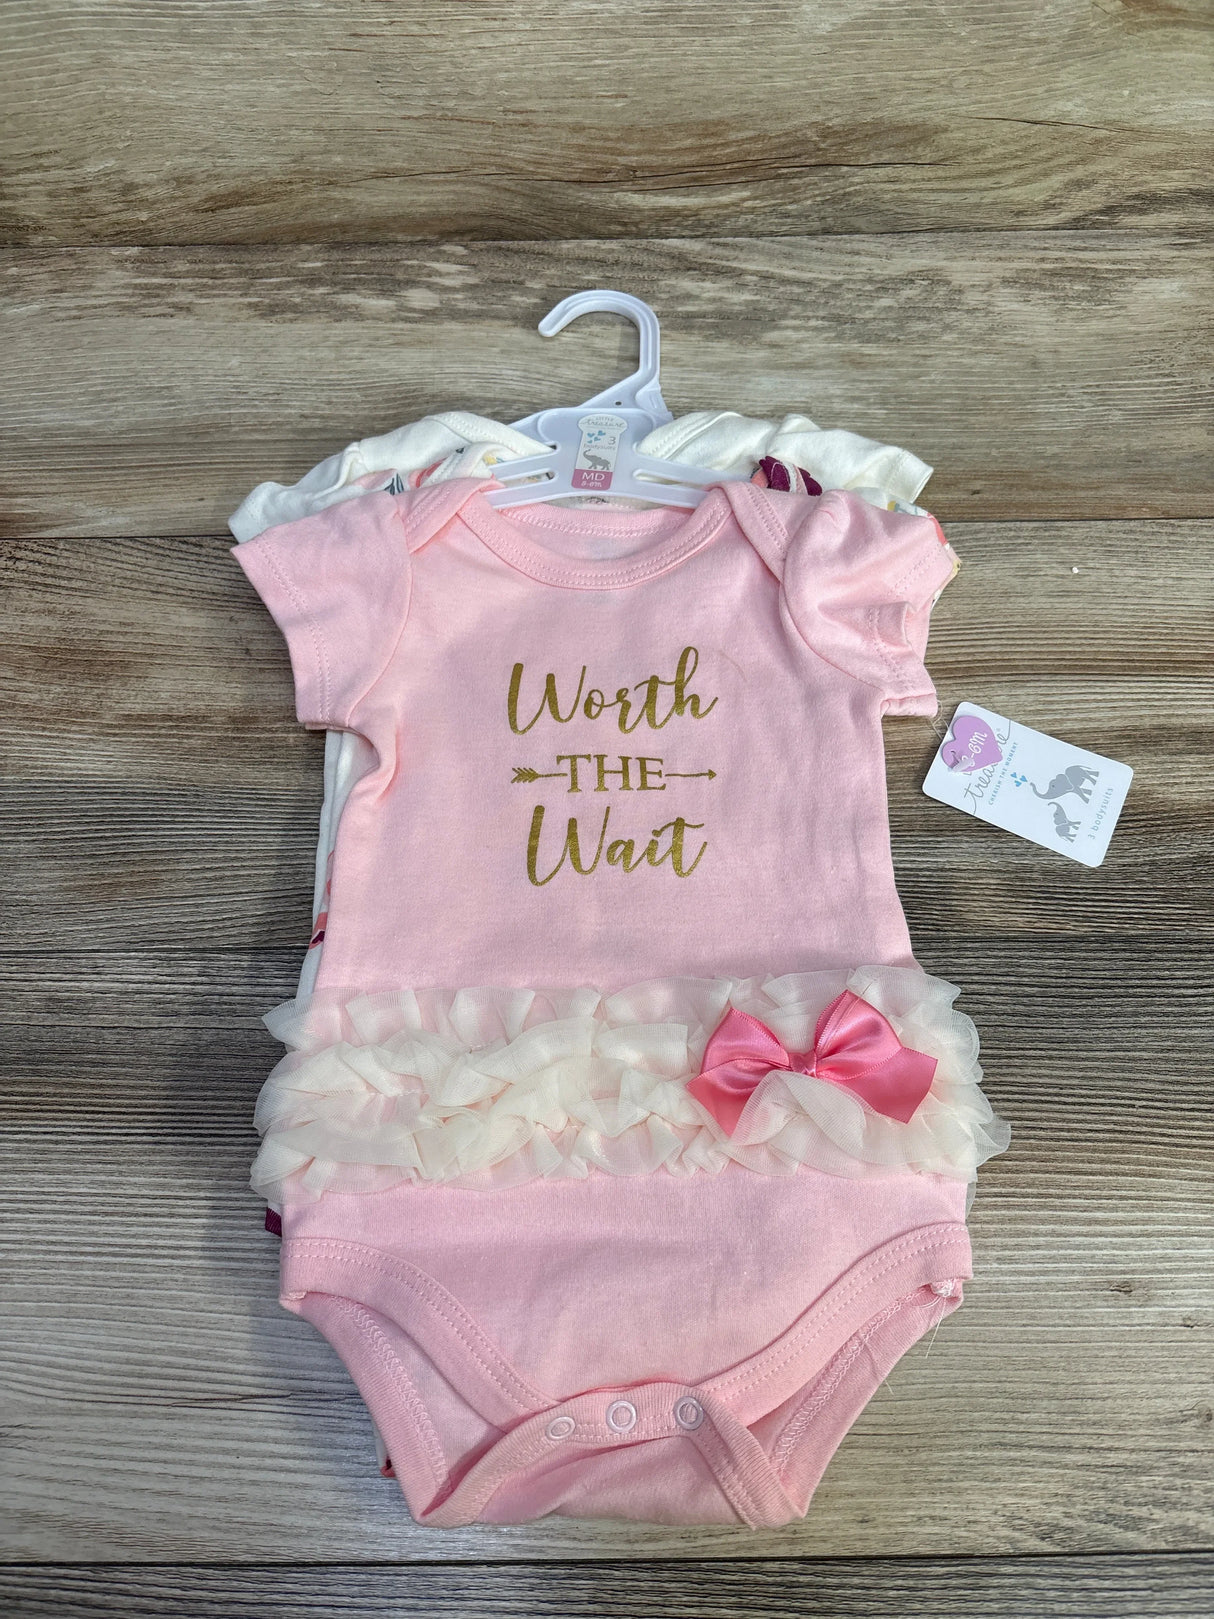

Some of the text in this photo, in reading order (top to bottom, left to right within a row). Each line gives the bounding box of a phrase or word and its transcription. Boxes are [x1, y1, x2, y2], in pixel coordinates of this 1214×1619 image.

[607, 436, 616, 445] 3
[582, 472, 605, 481] MD
[508, 646, 718, 735] Worth
[556, 754, 667, 793] THE
[988, 742, 1018, 805] CHERISH THE MOMENT
[1092, 788, 1114, 832] bodysuits
[527, 805, 708, 887] Wait
